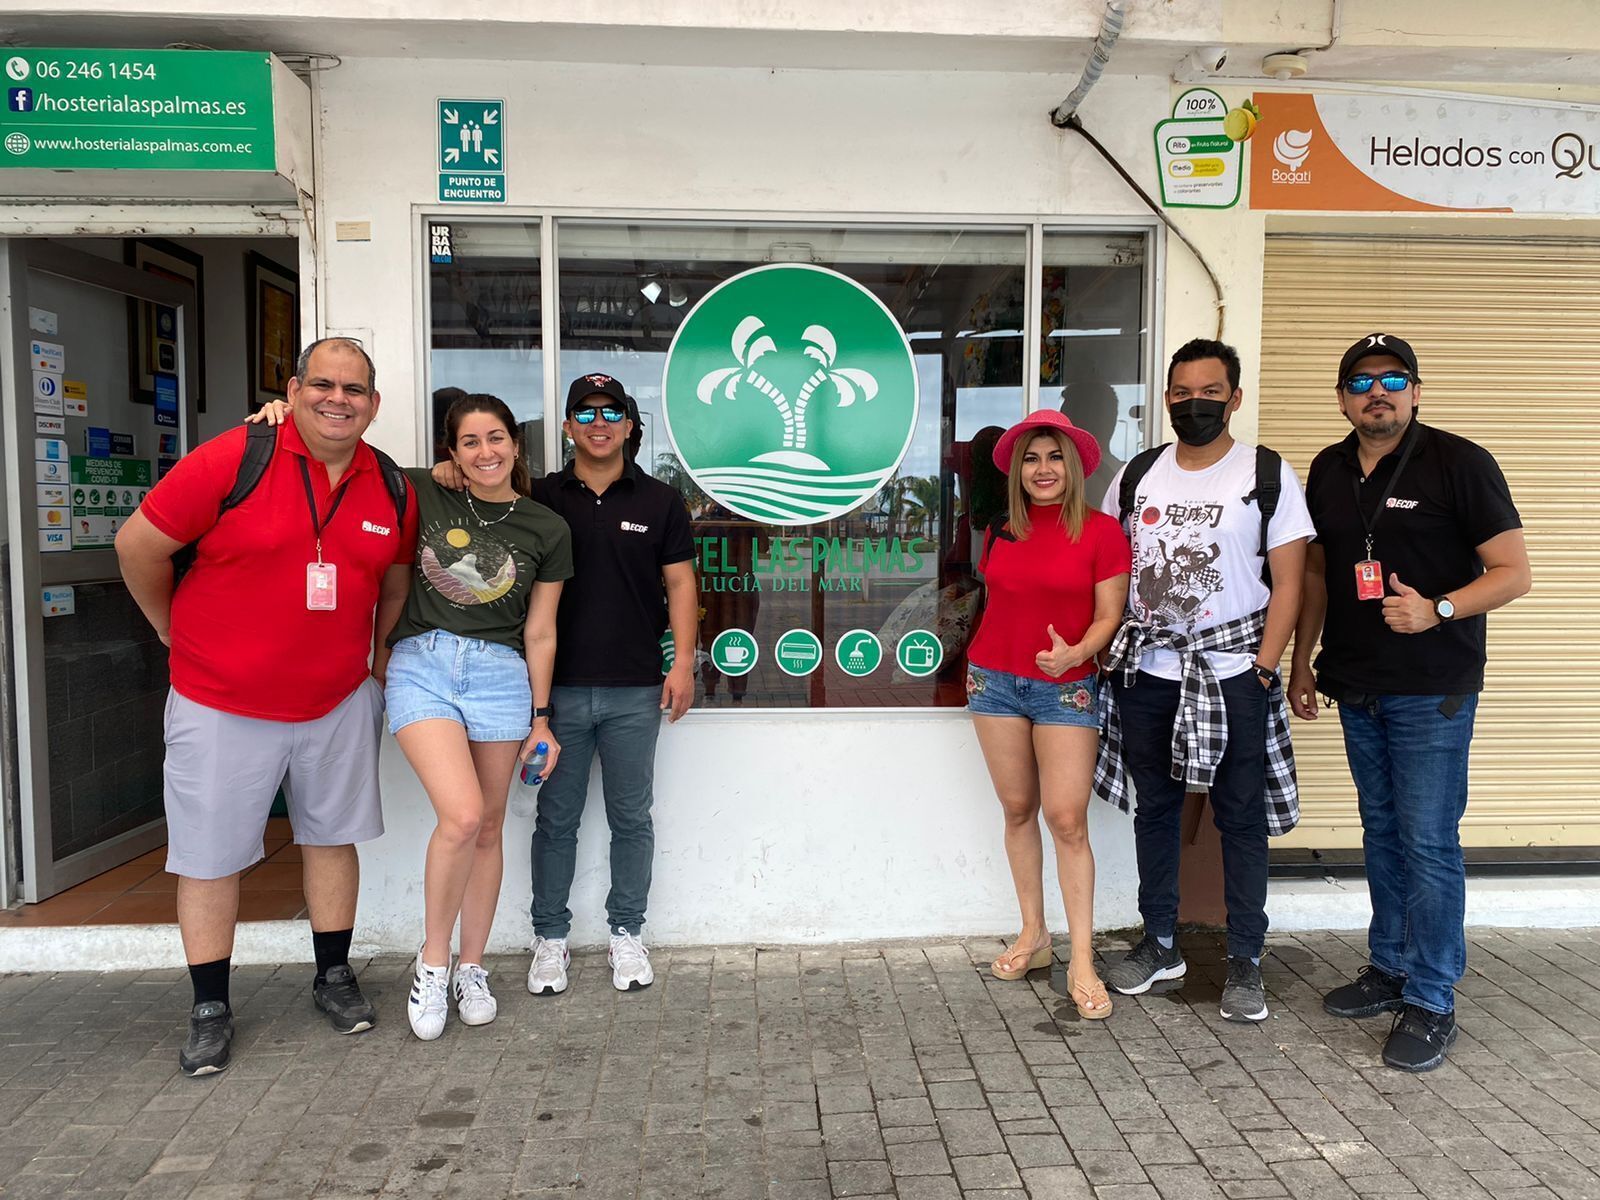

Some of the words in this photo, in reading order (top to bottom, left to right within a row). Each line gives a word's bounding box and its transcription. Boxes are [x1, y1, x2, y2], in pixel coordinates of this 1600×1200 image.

[36, 61, 60, 78] 06
[66, 61, 102, 79] 246
[109, 62, 156, 80] 1454
[35, 92, 246, 118] /hosterialaspalmas.es
[1186, 98, 1216, 110] 100%
[34, 137, 252, 154] www.hosterialaspalmas.com.ec
[1370, 136, 1502, 167] Helados
[1508, 149, 1545, 165] con
[449, 177, 481, 187] PUNTO
[484, 178, 496, 187] DE
[1272, 169, 1311, 184] Bogati
[444, 188, 502, 199] ENCUENTRO
[431, 226, 449, 237] UR
[432, 236, 450, 246] BA
[431, 245, 452, 256] NA
[38, 420, 61, 429] DISCOVER
[86, 459, 112, 468] MEDIDAS
[1395, 499, 1419, 510] ECDF
[1132, 495, 1148, 537] Demon
[372, 525, 391, 536] ECDF
[629, 523, 649, 533] ECDF
[46, 533, 63, 542] VISA
[752, 536, 804, 574] LAS
[812, 536, 924, 574] PALMAS
[701, 573, 763, 592] LUCÍA
[772, 576, 810, 592] DEL
[818, 577, 864, 592] MAR
